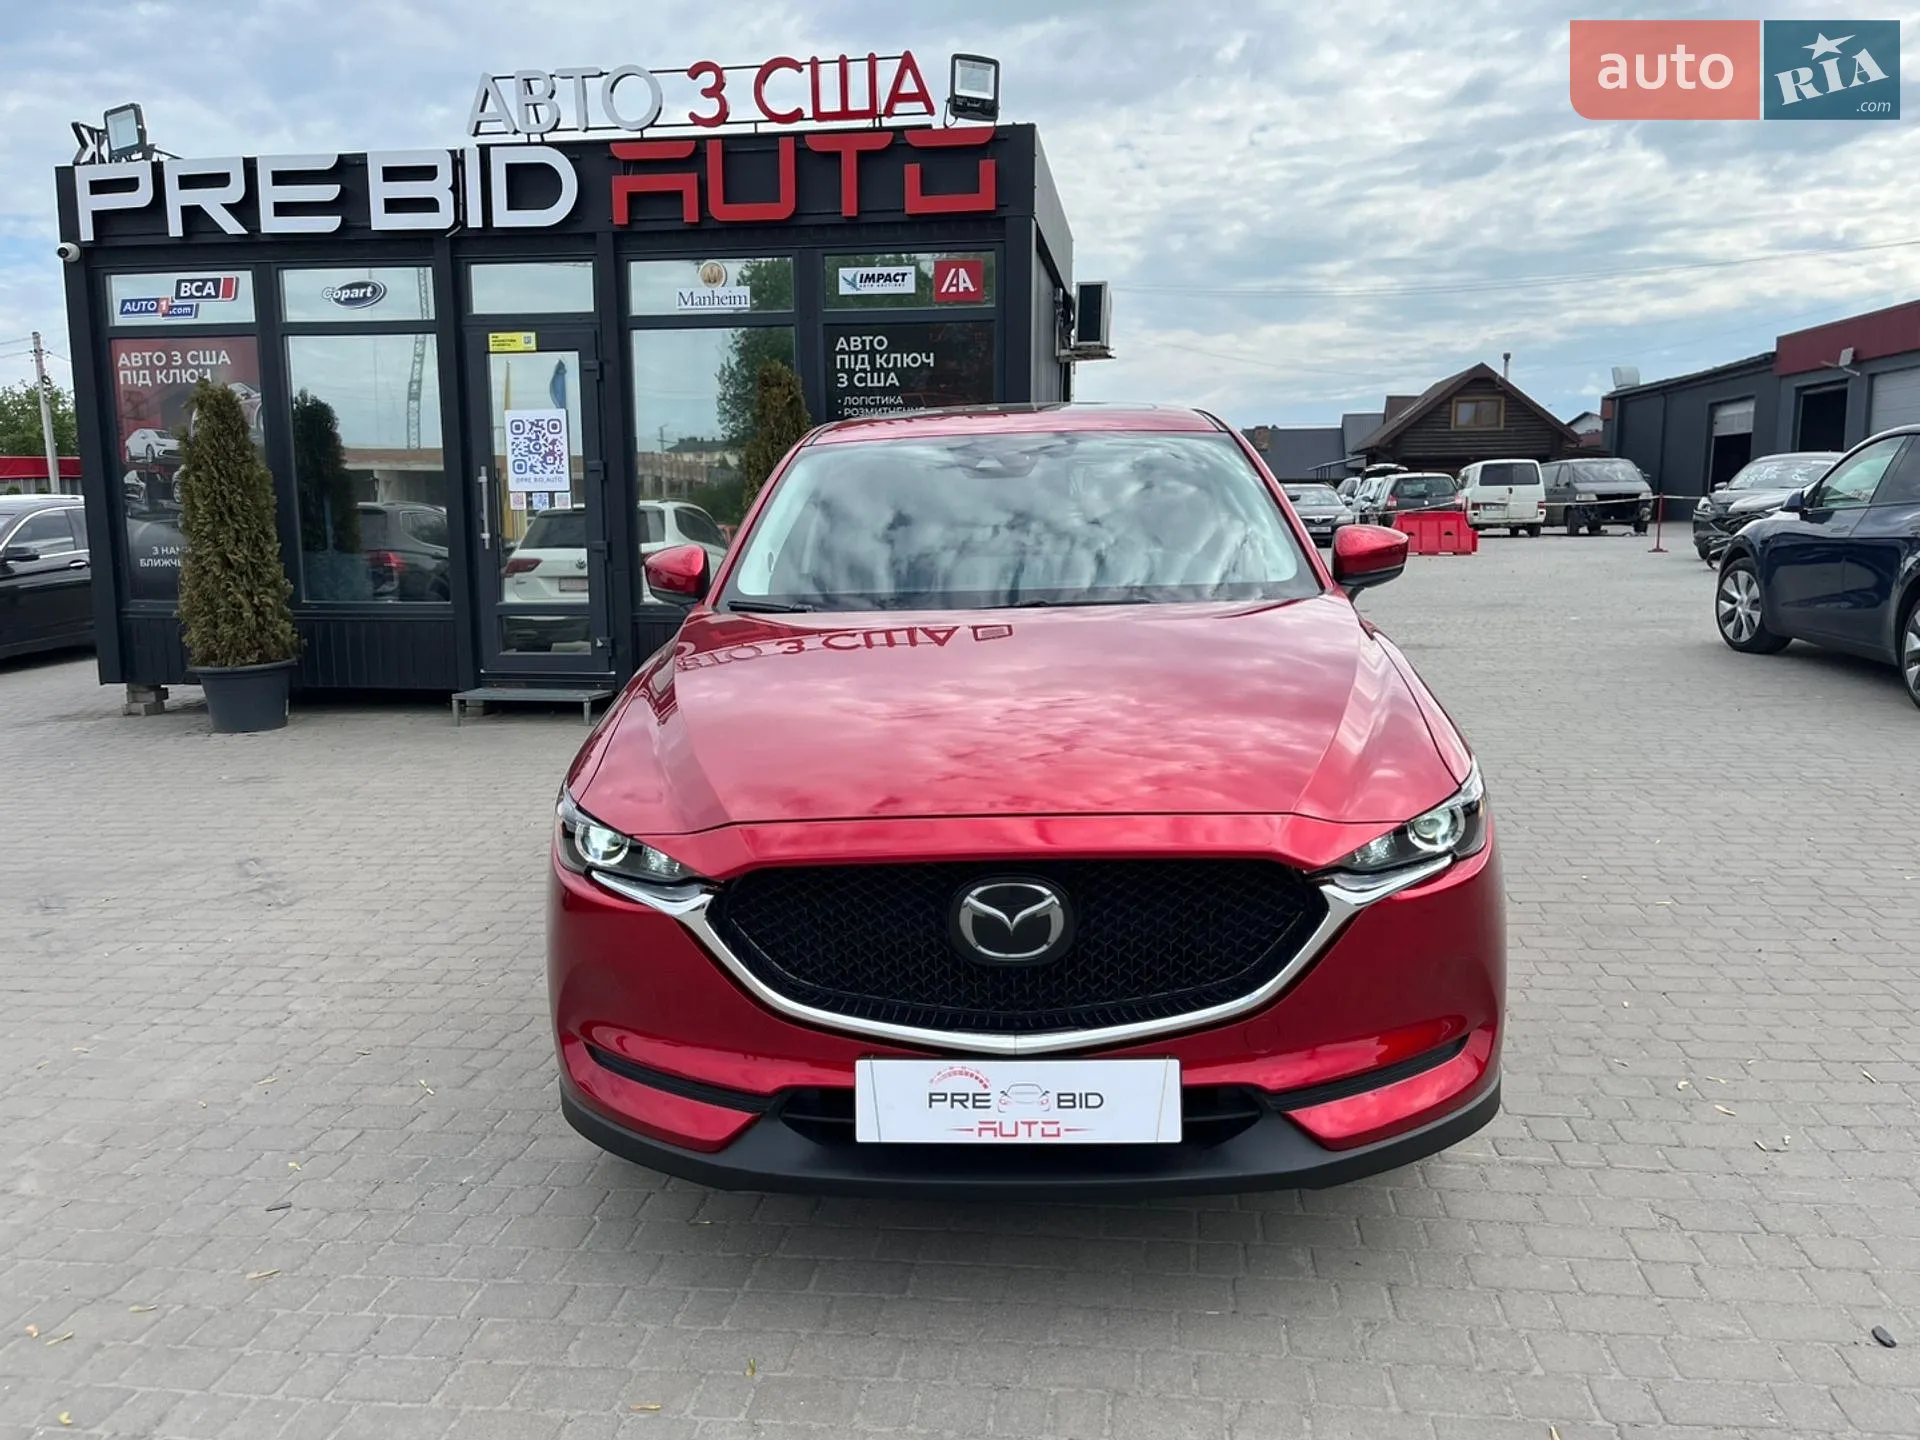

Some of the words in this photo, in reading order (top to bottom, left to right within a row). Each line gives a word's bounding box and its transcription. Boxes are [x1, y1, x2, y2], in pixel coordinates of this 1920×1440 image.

[467, 65, 663, 134] АВТО
[686, 61, 729, 128] З
[753, 50, 936, 123] США
[75, 152, 343, 241] PRE
[367, 146, 578, 231] BID
[610, 127, 996, 226] AUTO
[859, 272, 908, 283] IMPACT
[180, 281, 216, 297] BCA
[322, 286, 374, 301] Copart
[678, 290, 748, 306] Manheim
[835, 335, 888, 351] АВТО
[118, 352, 166, 367] АВТО
[171, 352, 182, 366] З
[187, 350, 231, 365] США
[836, 354, 870, 371] ПІД
[876, 352, 934, 368] КЛЮЧ
[119, 370, 152, 387] ПІД
[837, 373, 848, 387] З
[853, 371, 899, 387] США
[843, 396, 903, 405] ЛОГІСТИКА
[928, 1092, 992, 1109] PRE
[1056, 1092, 1104, 1109] BID
[977, 1121, 1061, 1138] AUTO
